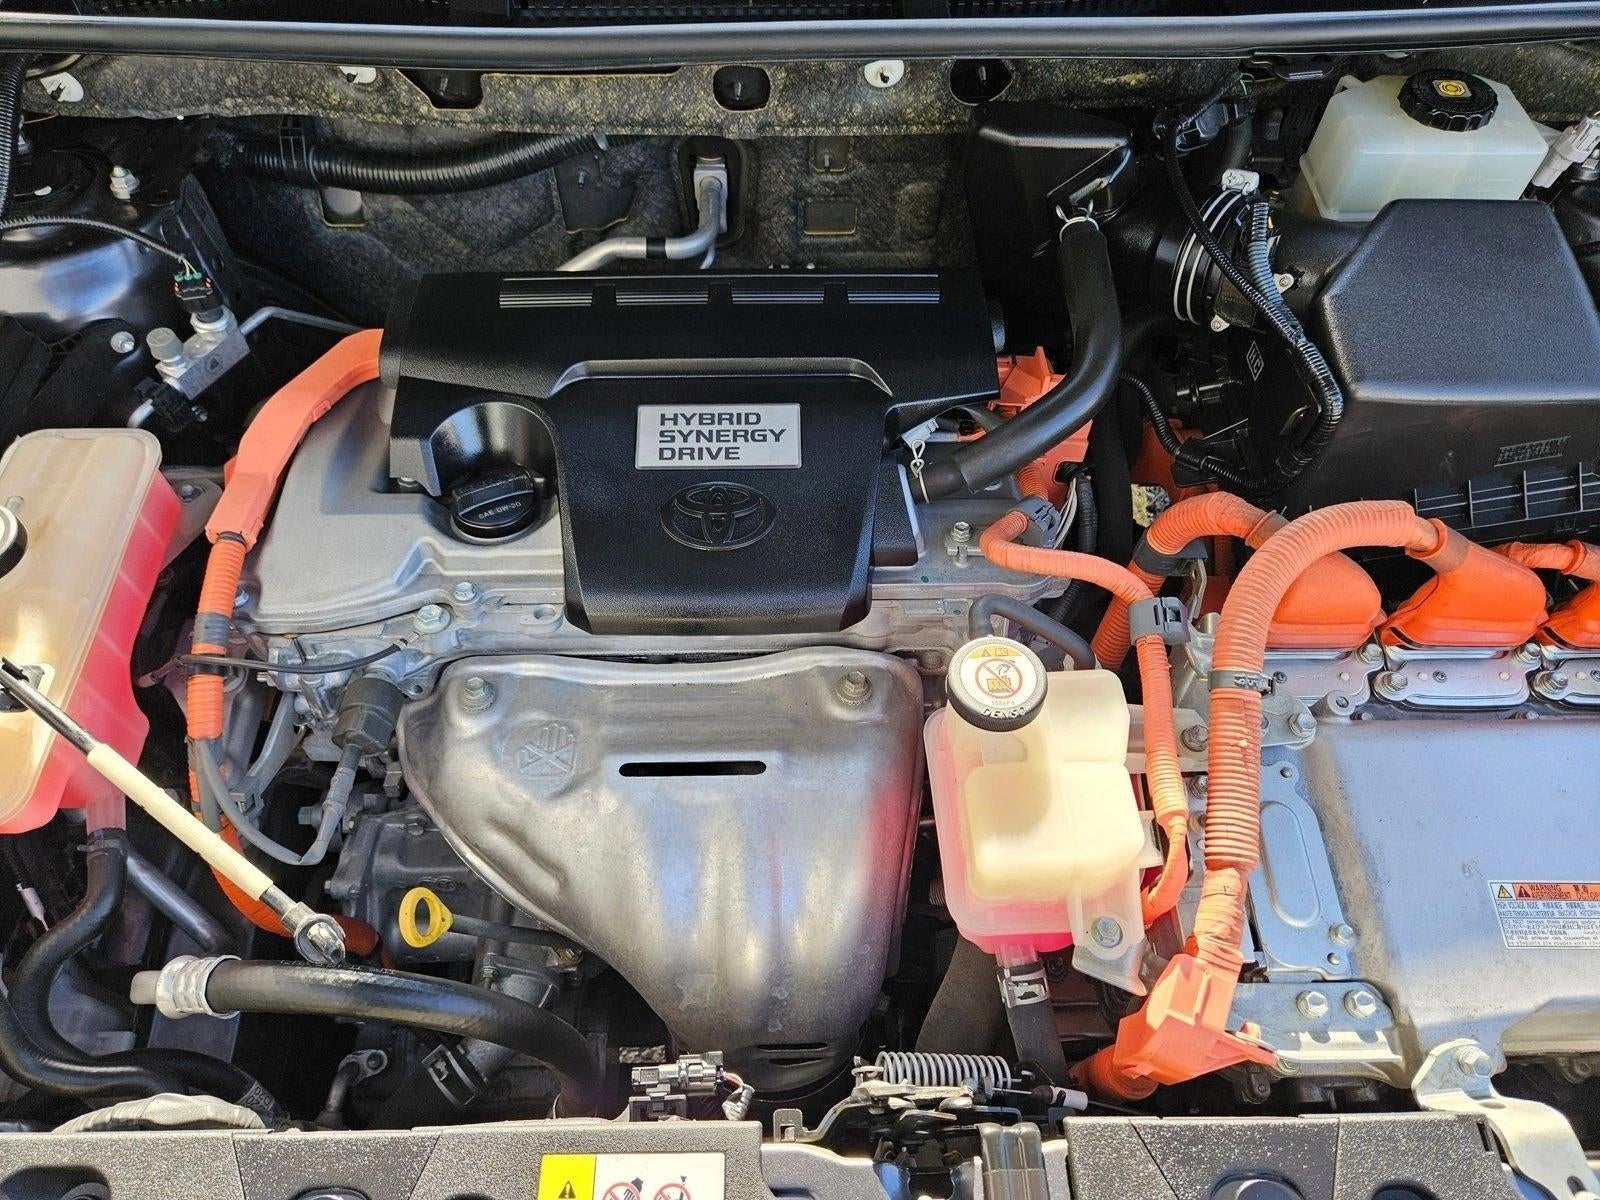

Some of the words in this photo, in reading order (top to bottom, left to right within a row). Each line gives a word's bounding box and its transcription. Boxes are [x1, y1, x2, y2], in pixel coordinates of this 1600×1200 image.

[660, 412, 761, 426] HYBRID
[658, 428, 787, 443] SYNERGY
[658, 446, 740, 460] DRIVE
[478, 509, 495, 520] SAE
[1528, 884, 1562, 892] WARNING
